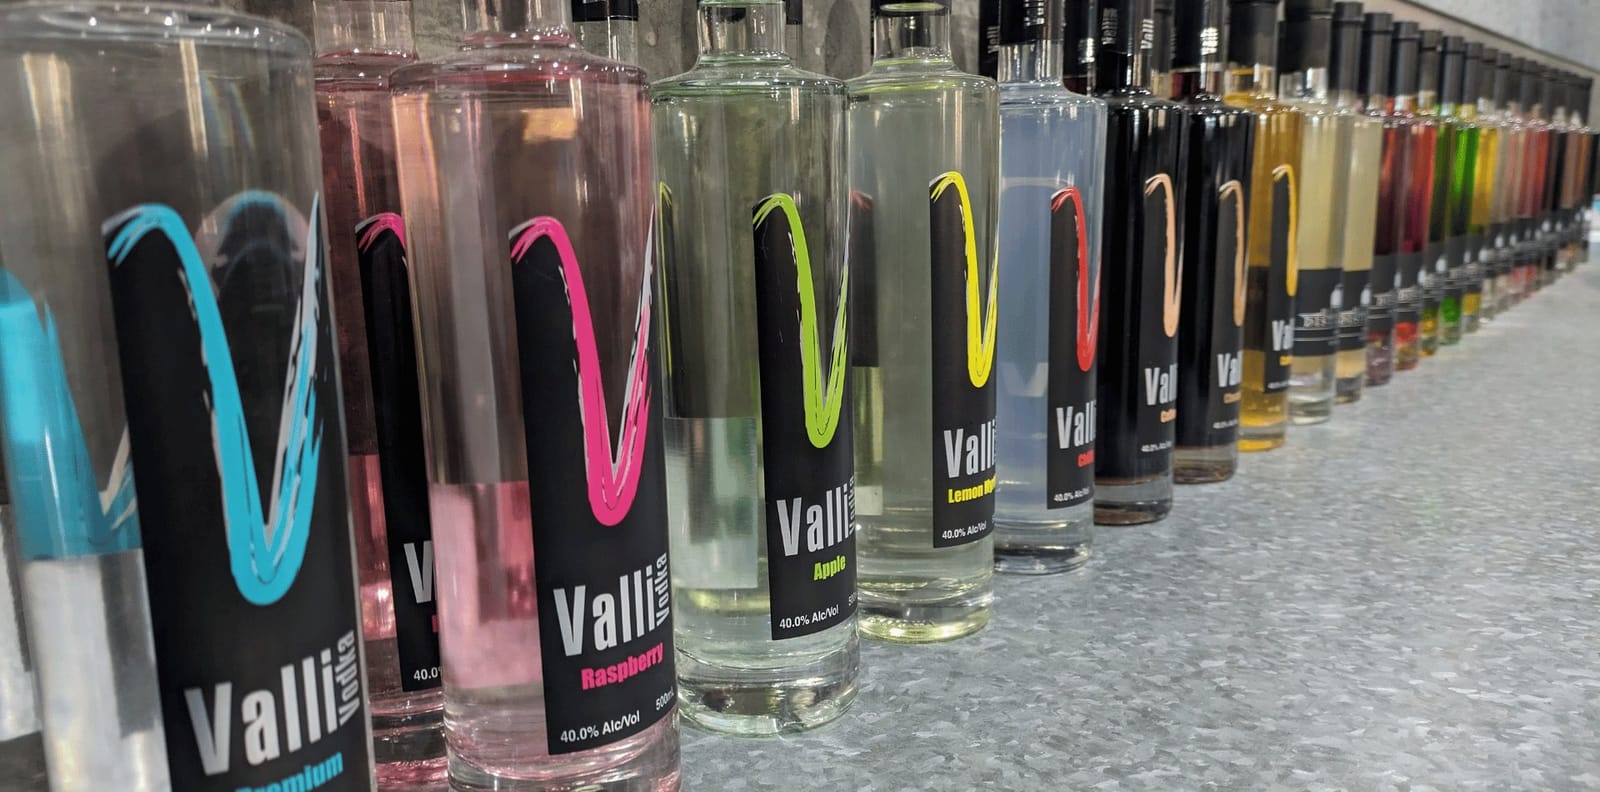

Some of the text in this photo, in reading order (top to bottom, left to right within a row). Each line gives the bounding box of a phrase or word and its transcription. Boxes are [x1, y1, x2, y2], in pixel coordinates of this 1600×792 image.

[947, 484, 984, 503] Lemon
[776, 483, 849, 557] Valli
[942, 528, 966, 539] 40.0%
[654, 552, 671, 627] Vodka
[813, 555, 846, 581] Apple
[553, 565, 655, 657] Valli
[779, 603, 840, 629] 40.0% Alc/Vol
[335, 629, 361, 727] Vodka
[580, 642, 664, 690] Raspberry
[184, 649, 338, 777] Valli
[560, 710, 641, 743] 40.0% Alc/Vol
[235, 751, 344, 792] mium
